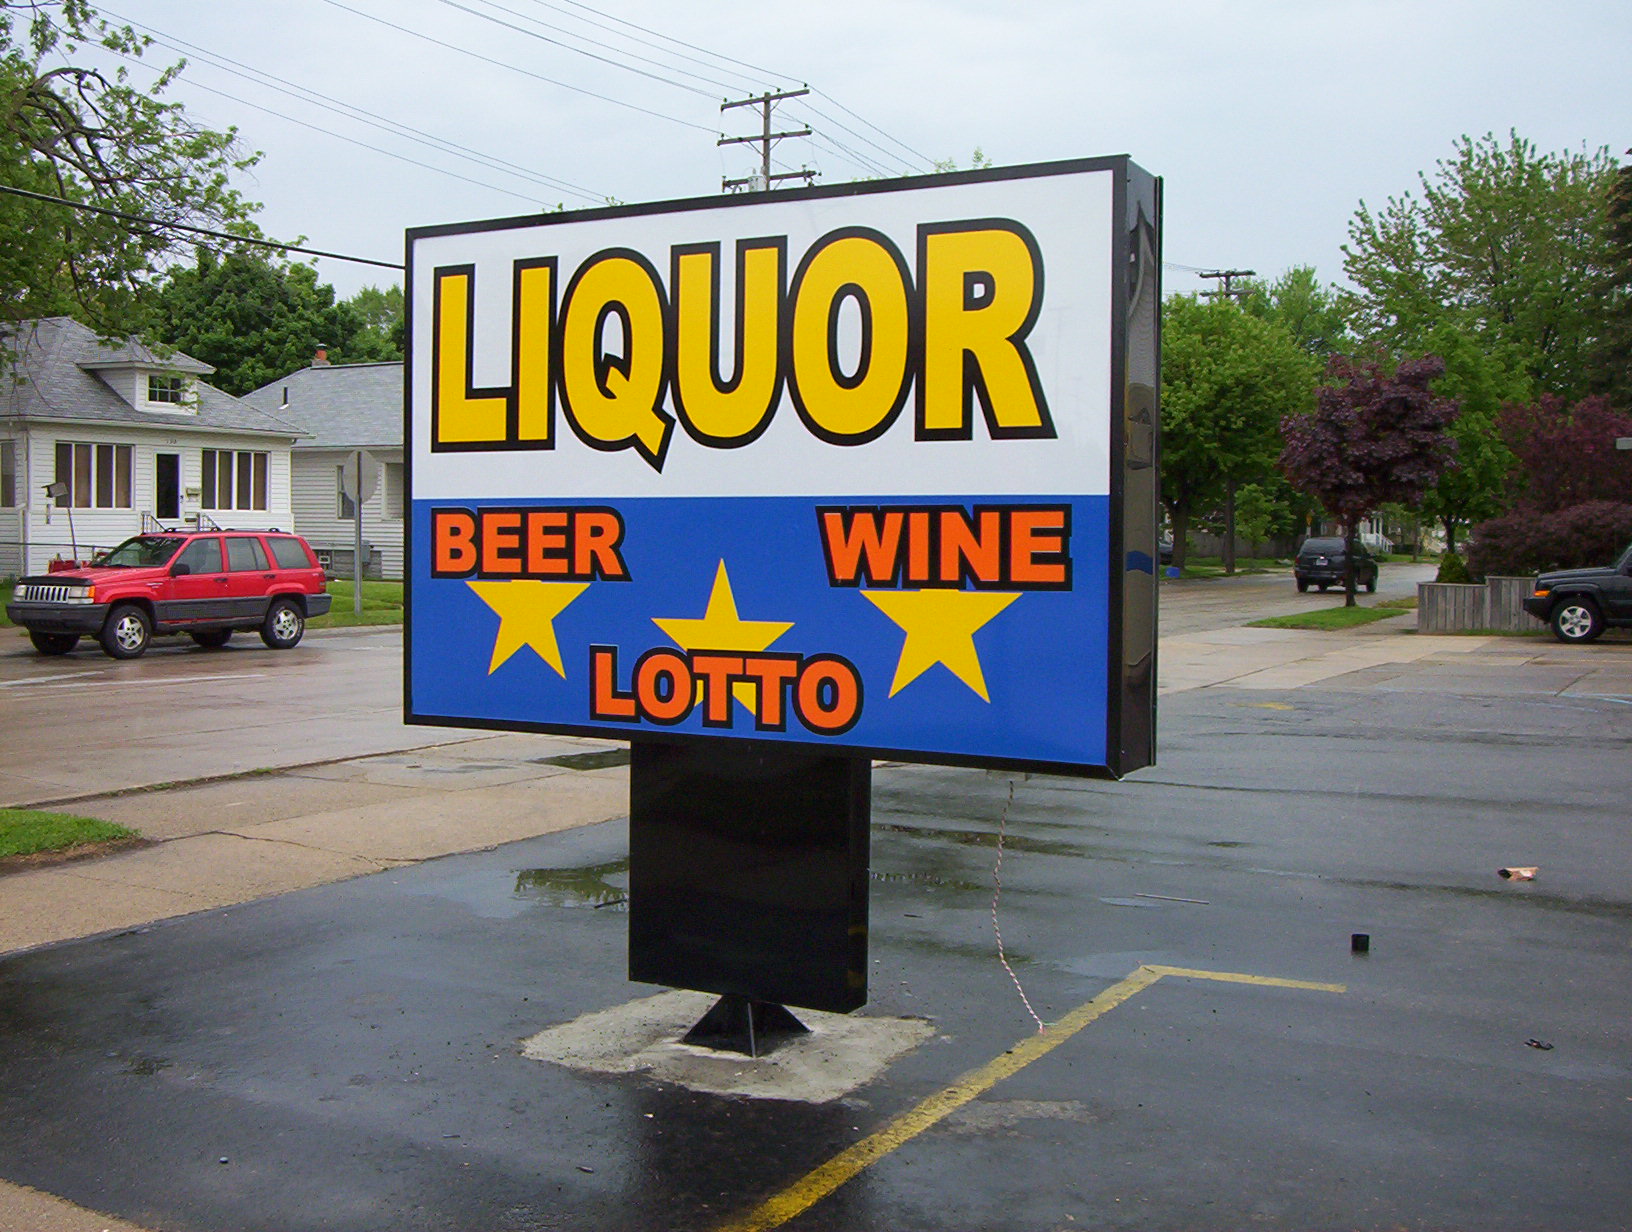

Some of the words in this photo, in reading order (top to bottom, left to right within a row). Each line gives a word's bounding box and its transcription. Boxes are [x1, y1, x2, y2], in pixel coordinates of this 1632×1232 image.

[433, 219, 1057, 473] LIQUOR
[431, 506, 631, 581] BEER
[816, 504, 1072, 590] WINE
[590, 645, 863, 736] LOTTO
